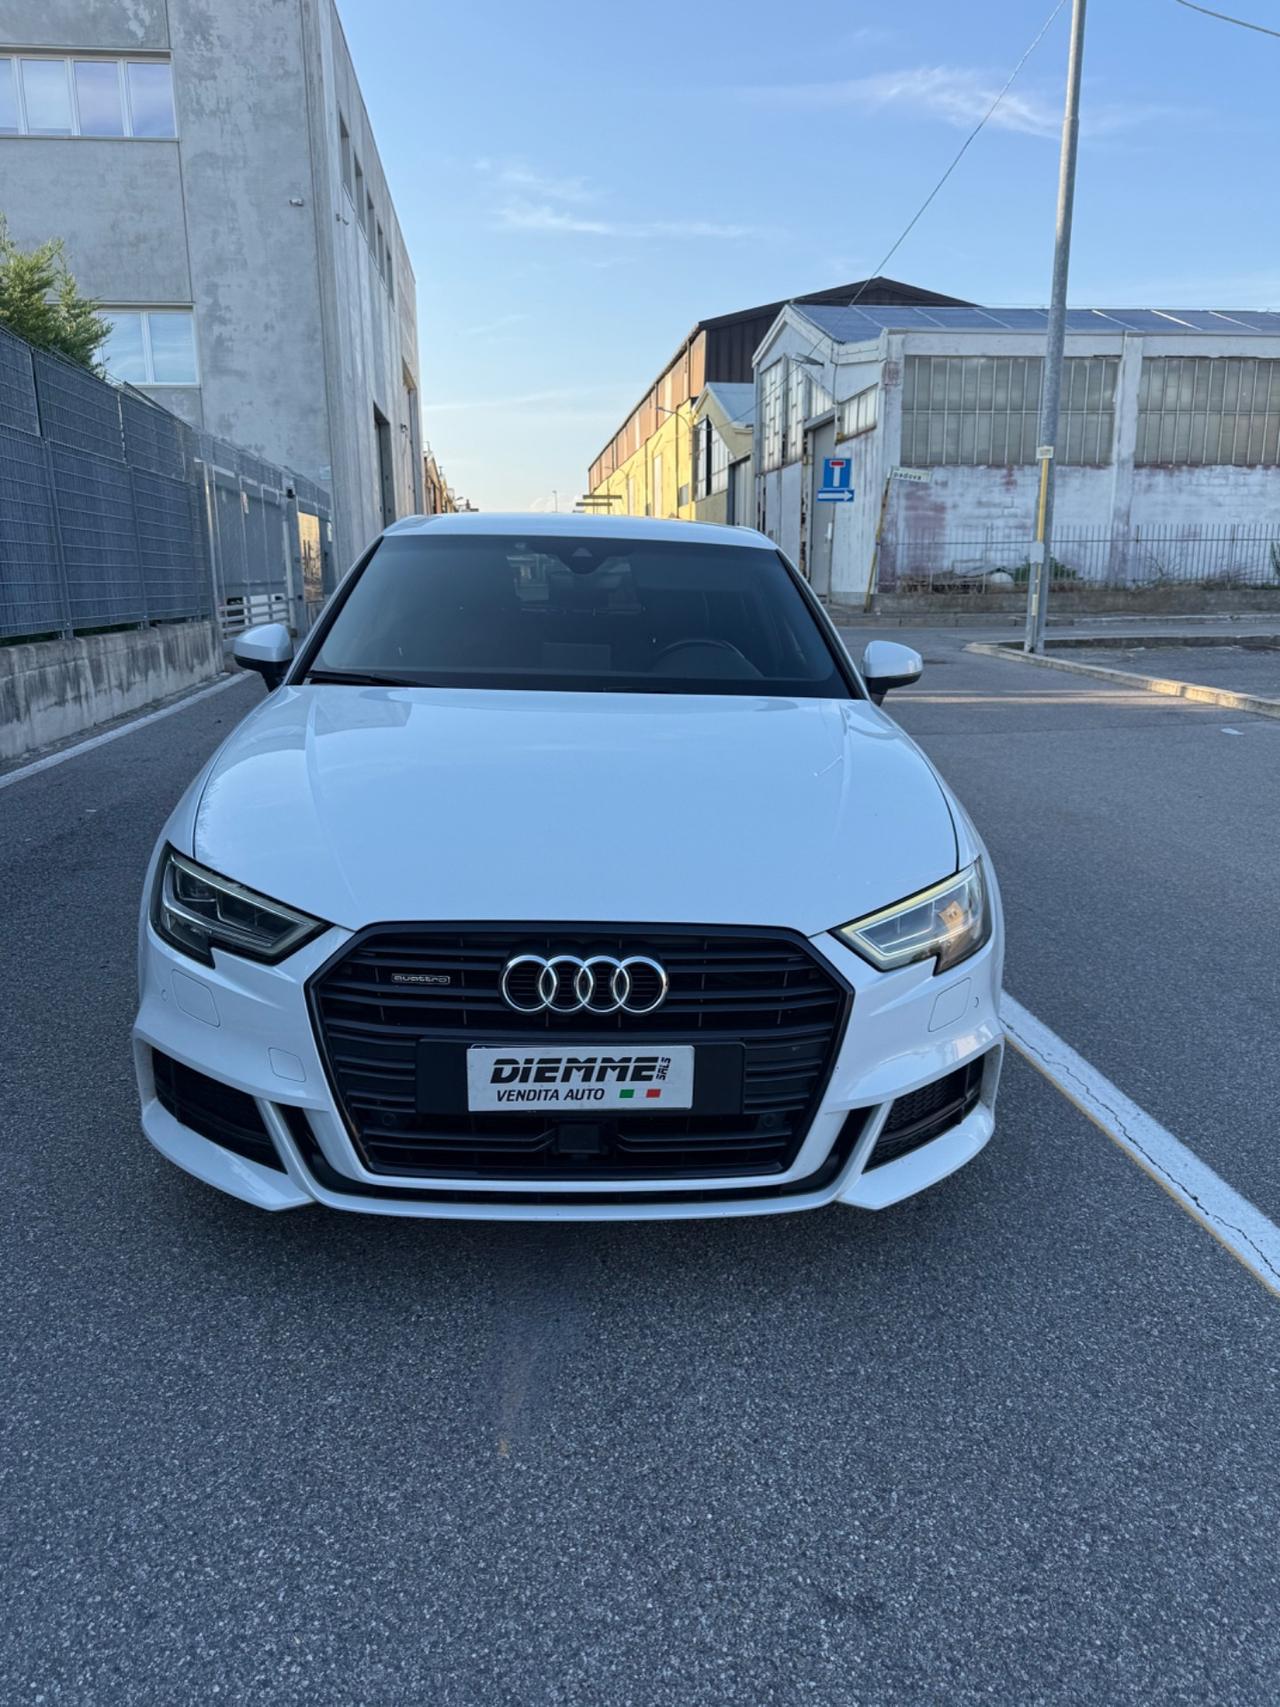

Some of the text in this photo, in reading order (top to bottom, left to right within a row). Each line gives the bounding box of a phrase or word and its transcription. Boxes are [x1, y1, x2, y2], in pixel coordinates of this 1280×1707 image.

[393, 975, 448, 983] quattro
[490, 1056, 659, 1084] DIEMME
[496, 1088, 605, 1102] VENDITA AUTO
